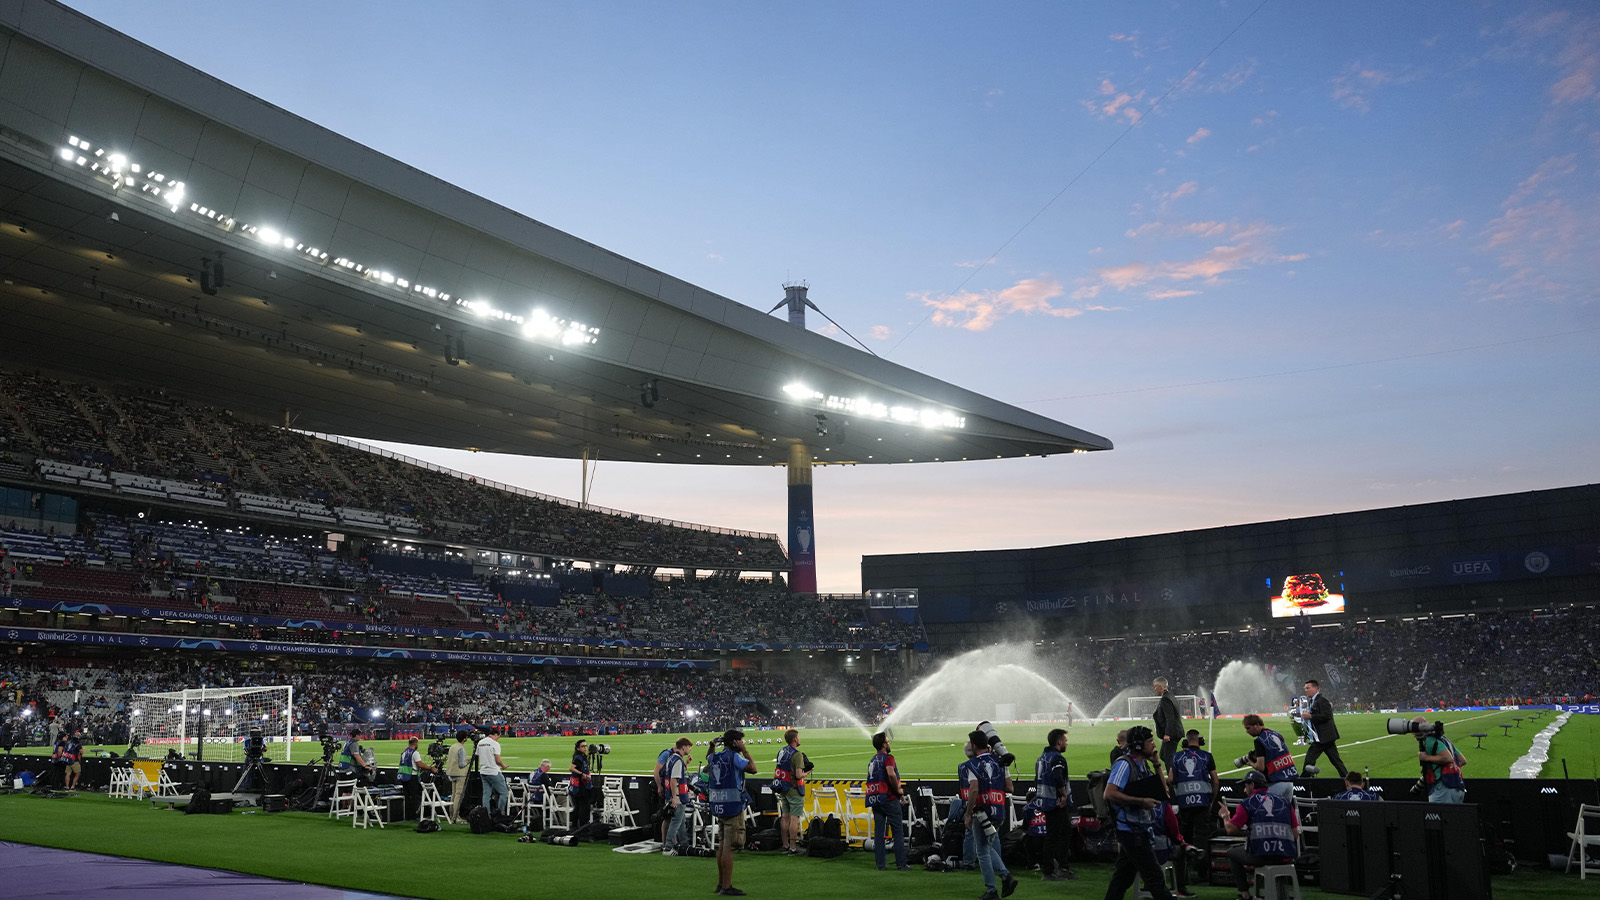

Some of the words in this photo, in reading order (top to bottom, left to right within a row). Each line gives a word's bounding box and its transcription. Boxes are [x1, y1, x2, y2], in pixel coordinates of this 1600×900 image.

[1452, 562, 1493, 574] UEFA
[1084, 592, 1141, 607] FINAL
[159, 610, 178, 618] UEFA
[179, 612, 218, 621] CHAMPIONS
[82, 635, 123, 644] FINAL
[265, 644, 281, 652] UEFA
[1568, 705, 1600, 713] PS5
[1273, 755, 1292, 769] PHOT
[1282, 766, 1298, 779] 143
[1183, 782, 1202, 793] LED
[1185, 794, 1202, 805] 002
[1254, 824, 1287, 837] PITCH
